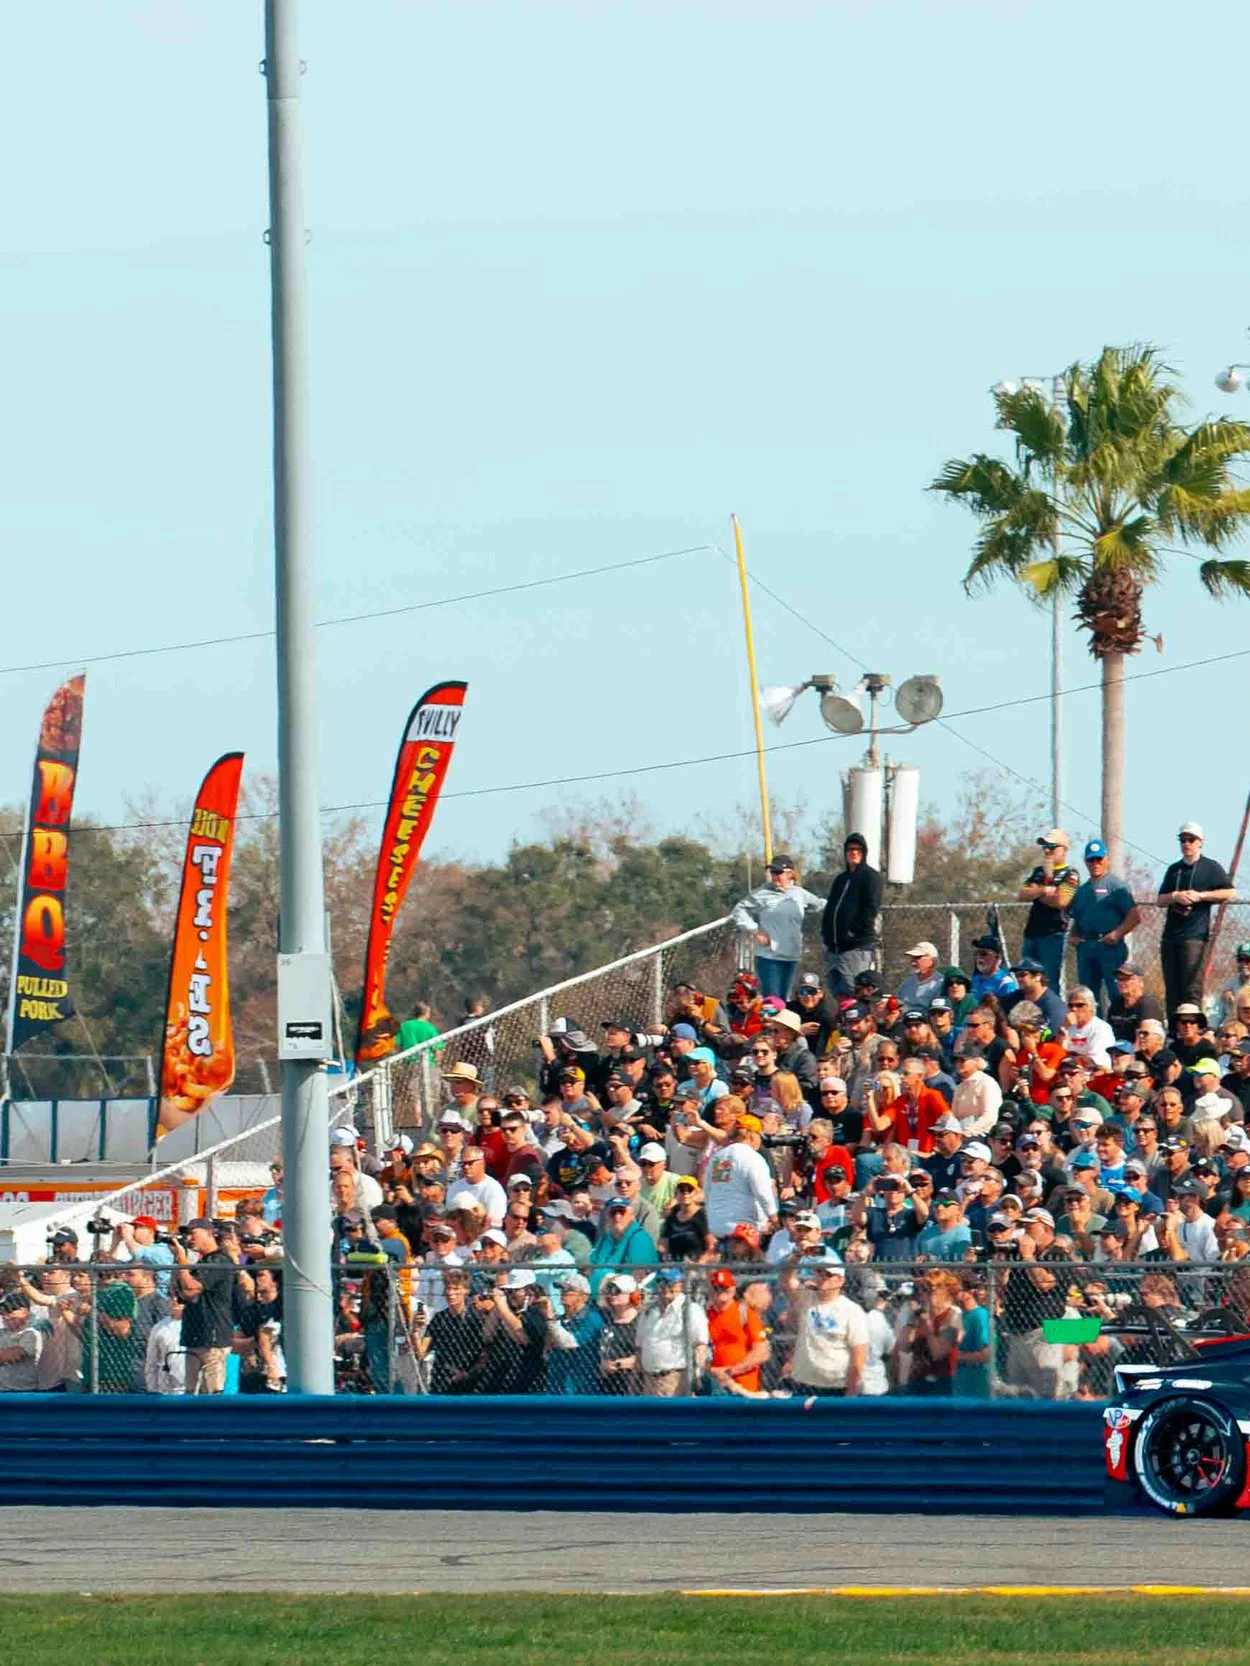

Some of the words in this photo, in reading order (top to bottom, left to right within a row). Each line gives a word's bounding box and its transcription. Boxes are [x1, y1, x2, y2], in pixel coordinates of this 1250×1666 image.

[21, 760, 74, 970] BBQ
[17, 975, 68, 998] PULLED
[19, 1000, 64, 1019] PORK
